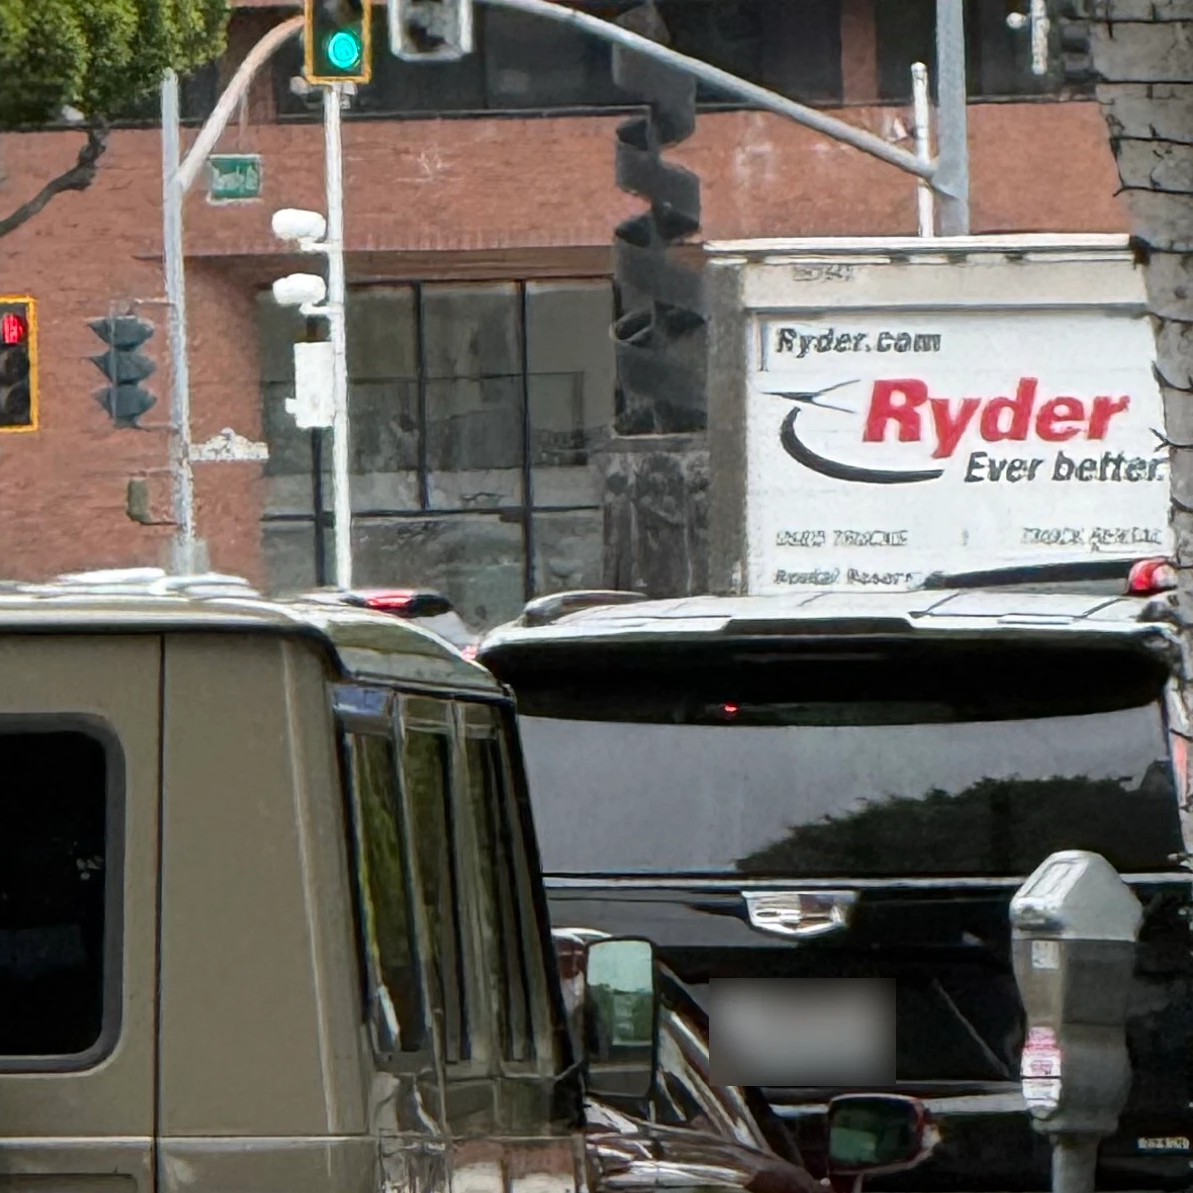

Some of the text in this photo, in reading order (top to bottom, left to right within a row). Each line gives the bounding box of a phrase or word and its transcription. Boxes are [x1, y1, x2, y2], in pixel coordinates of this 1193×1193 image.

[775, 327, 942, 358] Ryder.com
[862, 377, 1131, 459] Ryder
[964, 451, 1044, 483] Ever
